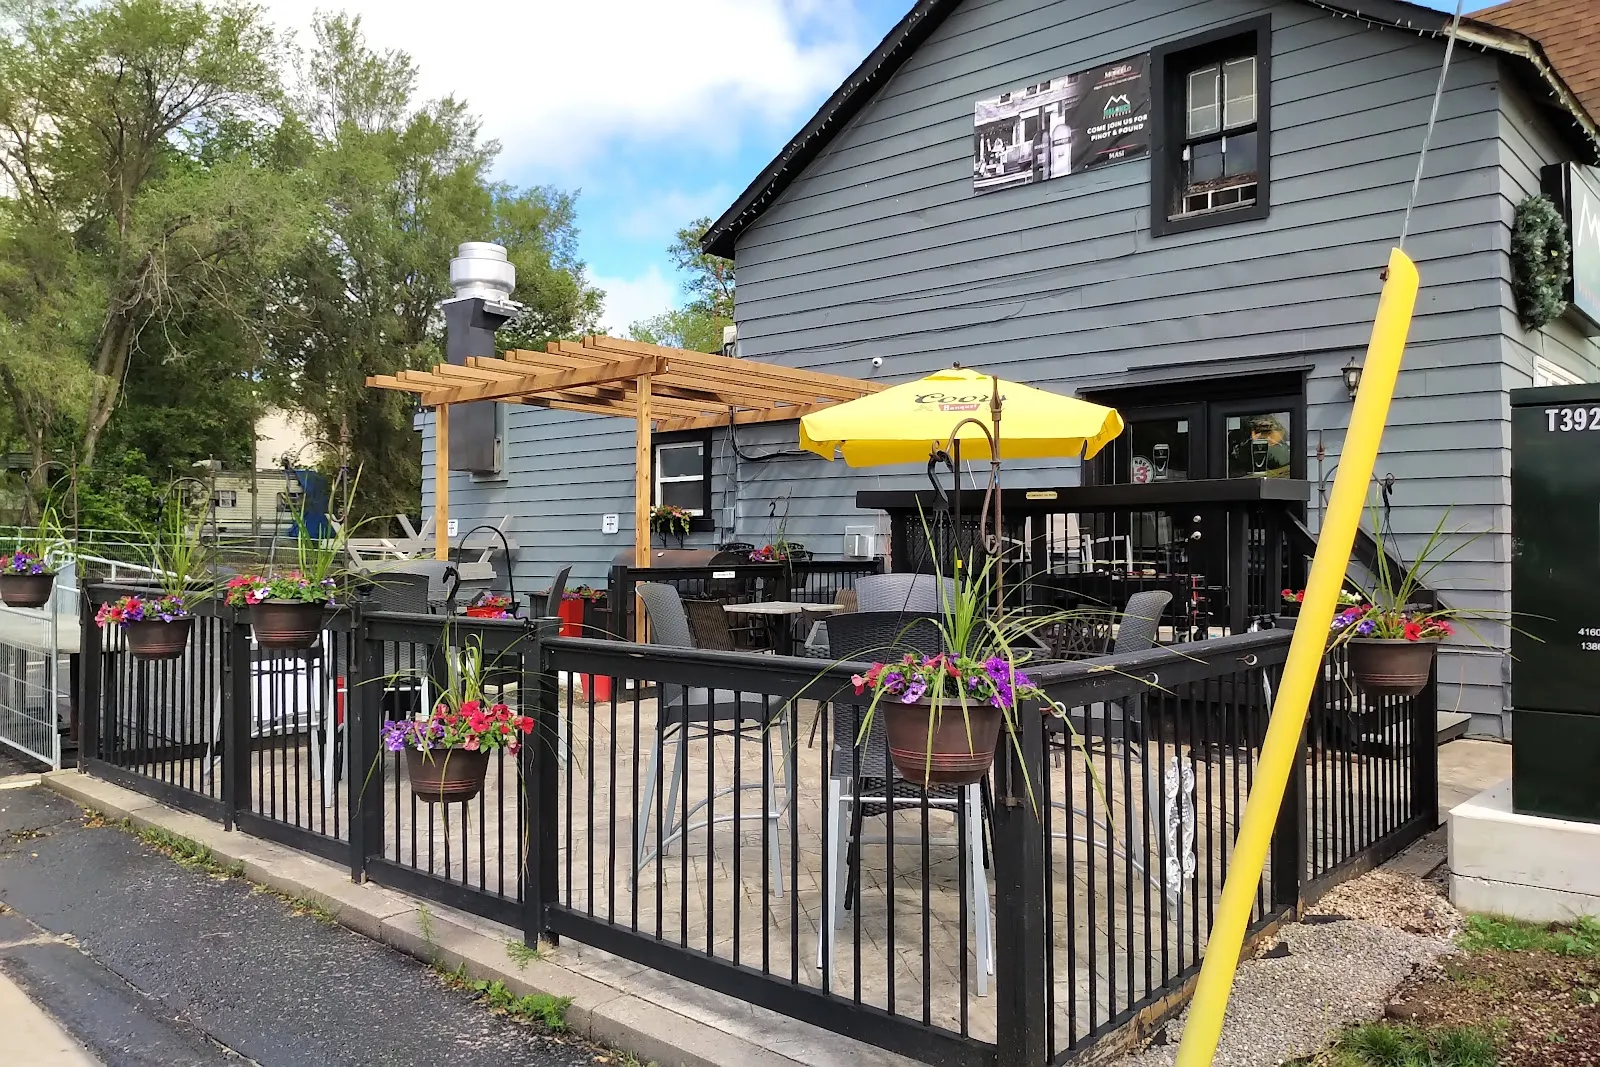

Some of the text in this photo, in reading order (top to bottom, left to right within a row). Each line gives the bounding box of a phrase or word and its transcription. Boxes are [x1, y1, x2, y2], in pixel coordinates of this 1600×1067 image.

[1087, 114, 1148, 134] COME JOIN US FOR
[1090, 131, 1111, 141] PINOT
[1118, 123, 1144, 135] POUND
[1108, 150, 1125, 159] MASI
[1545, 407, 1600, 432] T392
[1577, 627, 1600, 637] 4160
